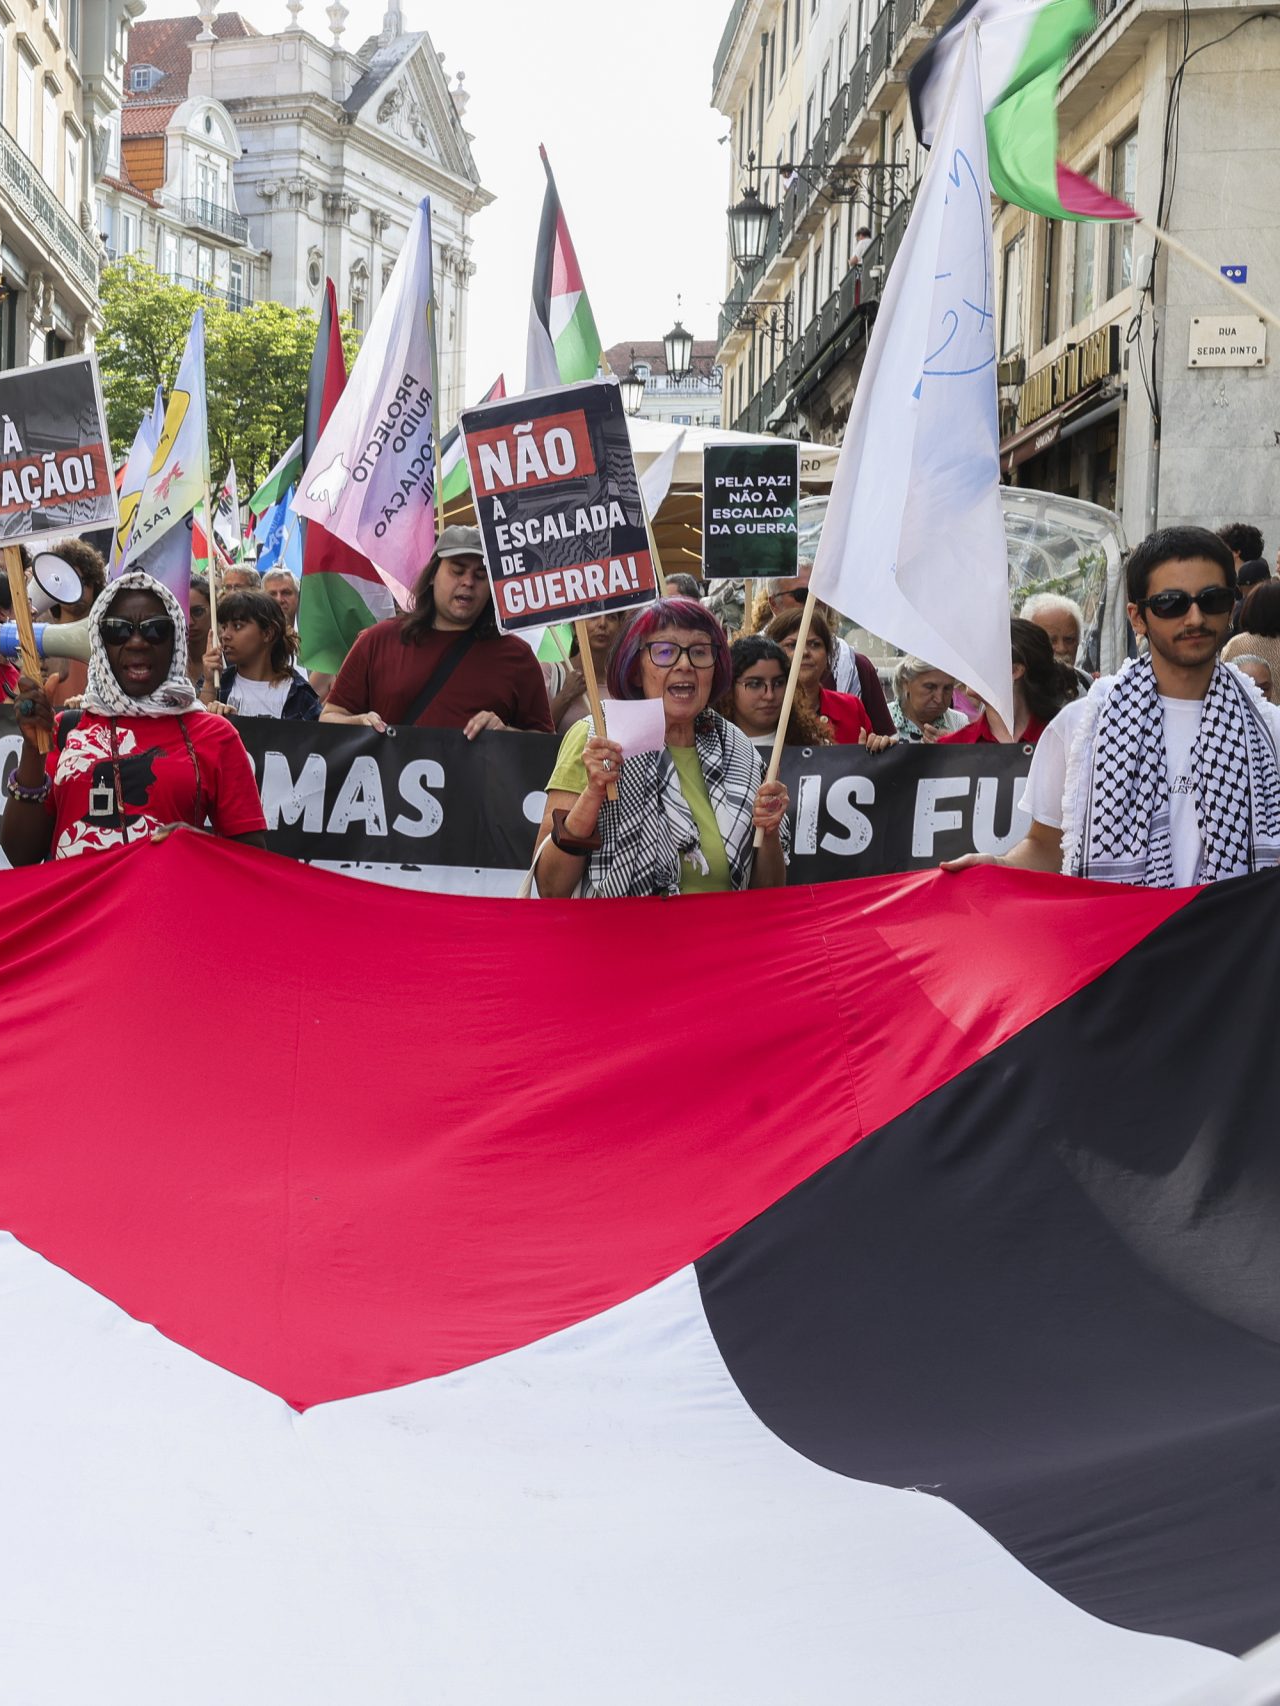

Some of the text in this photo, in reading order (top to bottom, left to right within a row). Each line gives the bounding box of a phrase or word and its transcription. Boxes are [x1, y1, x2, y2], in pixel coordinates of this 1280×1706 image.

[1219, 327, 1237, 337] RUA
[1197, 346, 1258, 356] SERPA PINTO
[1, 414, 23, 455] À
[477, 421, 576, 491] NÃO
[800, 459, 821, 472] RD
[715, 475, 791, 488] PELA PAZ!
[729, 489, 777, 503] NÃO À
[492, 495, 507, 521] À
[712, 507, 794, 519] ESCALADA
[495, 501, 626, 551] ESCALADA
[710, 523, 797, 535] DA GUERRA
[501, 553, 526, 576] DE
[503, 556, 640, 614] GUERRA!
[248, 751, 445, 838] MAS
[794, 775, 875, 856] IS
[911, 776, 1032, 857] FU
